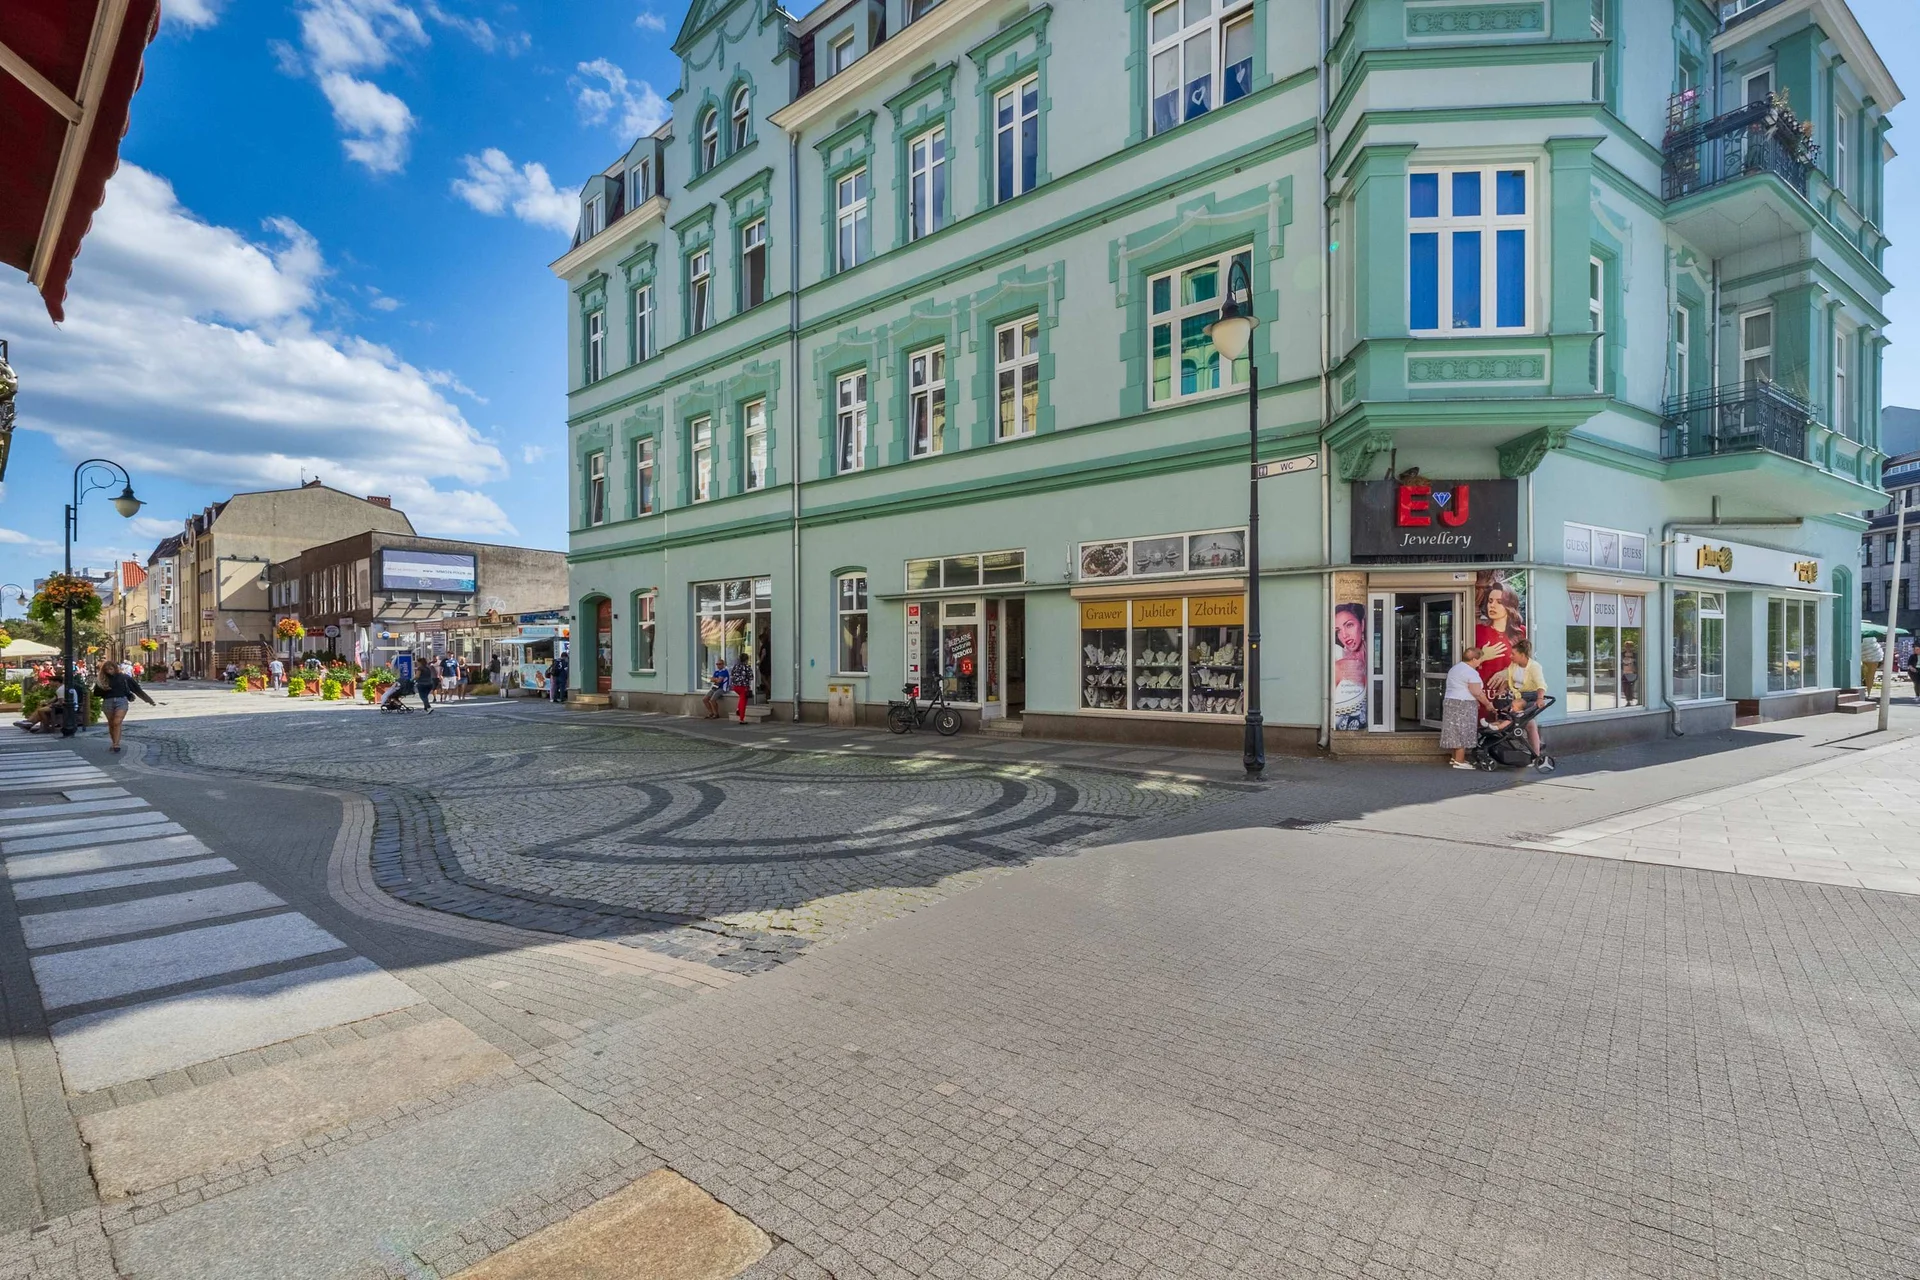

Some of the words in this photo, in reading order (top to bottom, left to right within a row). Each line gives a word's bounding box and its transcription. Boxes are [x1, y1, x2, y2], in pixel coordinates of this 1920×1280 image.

[1280, 462, 1294, 471] WC
[1399, 531, 1472, 548] Jewellery
[1565, 538, 1589, 552] GUESS
[1622, 547, 1642, 559] GUESS
[1086, 608, 1122, 619] Grawer
[1138, 605, 1176, 621] Jubiler
[1194, 600, 1238, 616] Złotnik
[1594, 603, 1615, 615] GUESS
